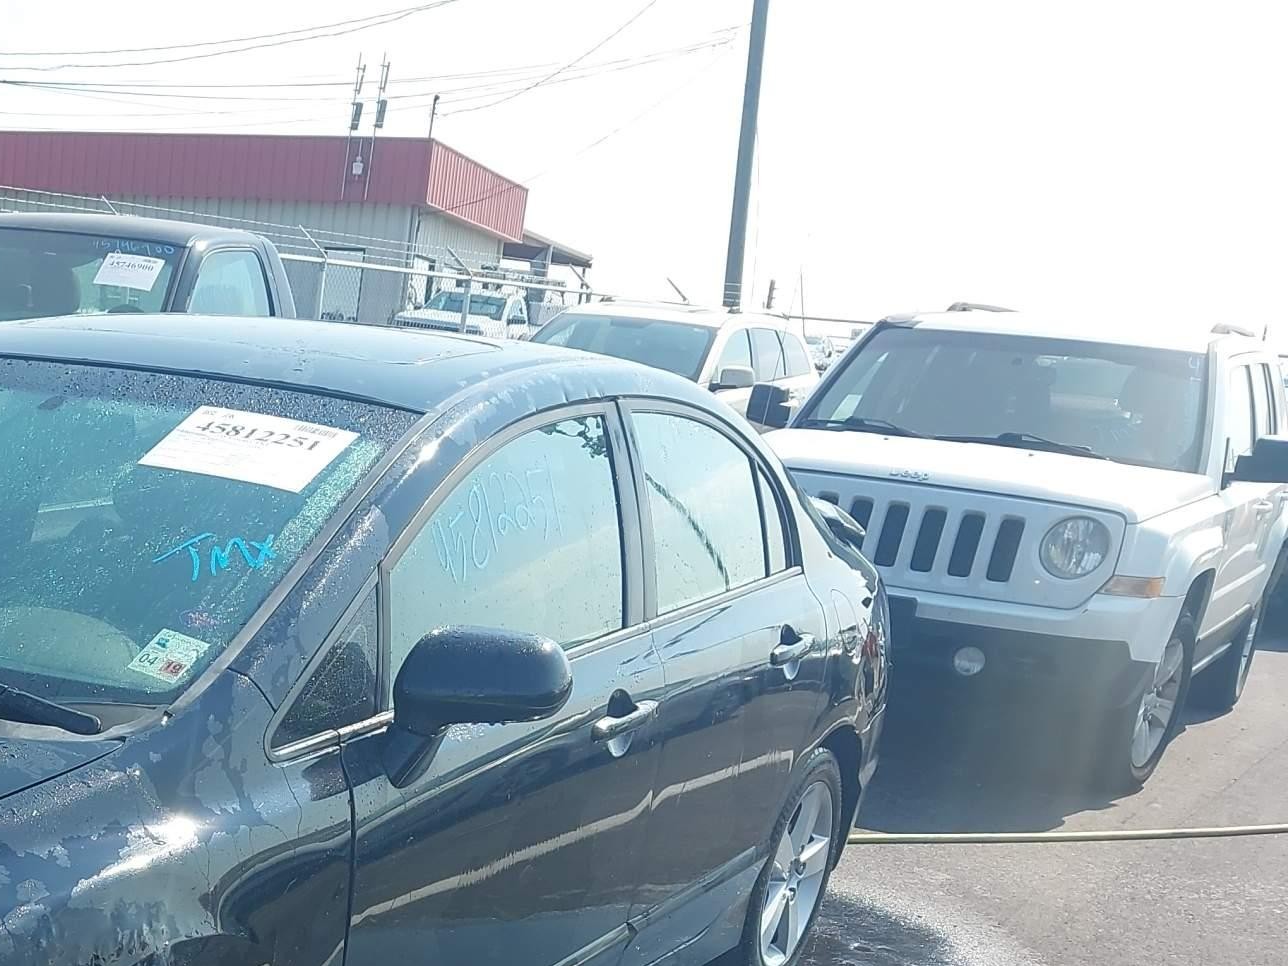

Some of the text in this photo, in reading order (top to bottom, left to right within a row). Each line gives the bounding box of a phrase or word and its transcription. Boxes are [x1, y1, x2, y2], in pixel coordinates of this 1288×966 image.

[196, 420, 321, 451] 45812251
[431, 454, 563, 585] 45812251
[138, 653, 184, 674] 04 19
